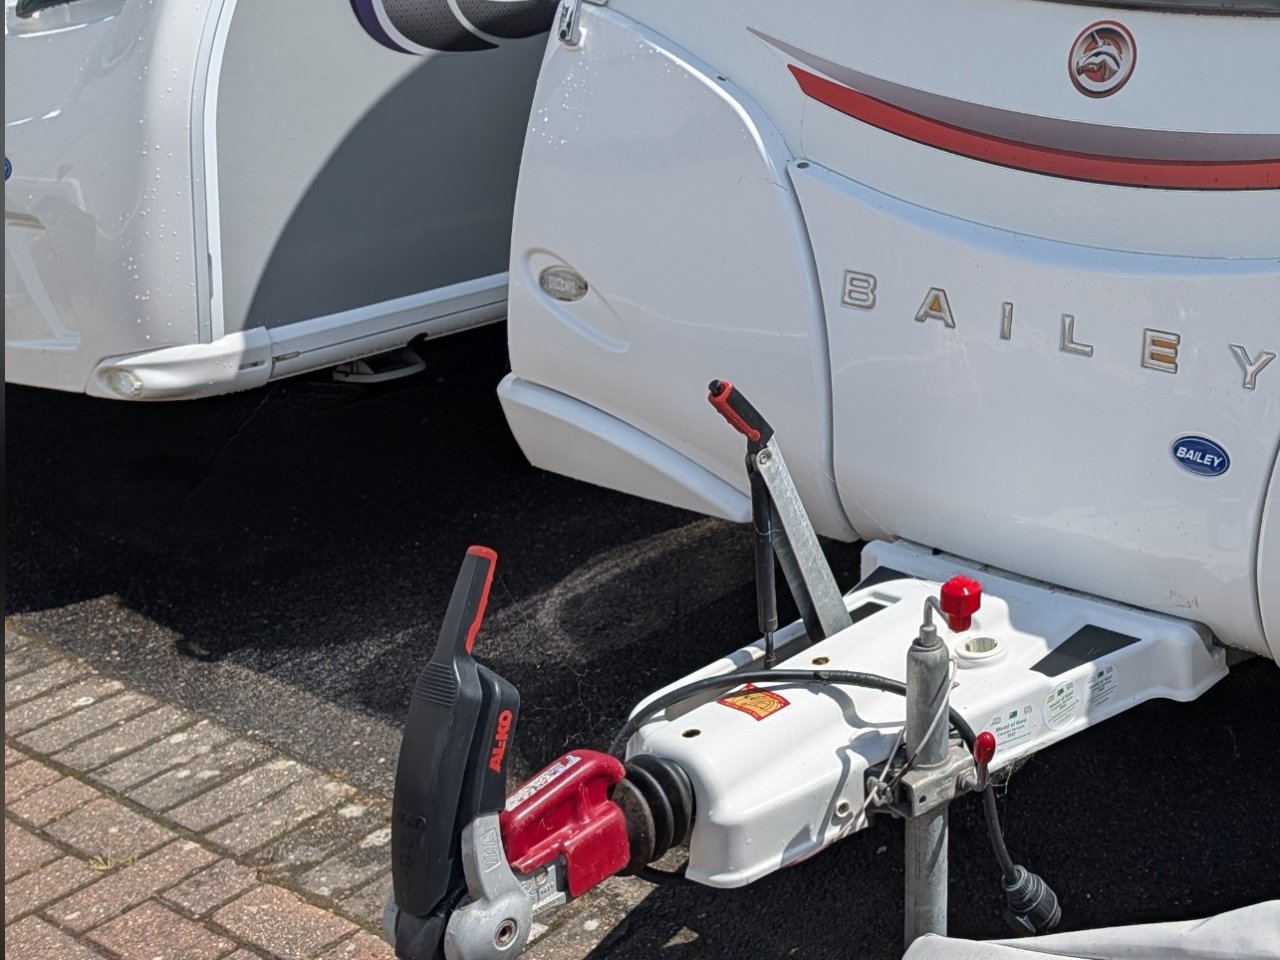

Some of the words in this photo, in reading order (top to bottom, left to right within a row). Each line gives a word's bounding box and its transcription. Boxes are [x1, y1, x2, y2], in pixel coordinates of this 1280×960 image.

[841, 269, 1276, 390] BAILEY
[1176, 446, 1223, 467] BAILEY
[489, 709, 513, 774] AL-KO
